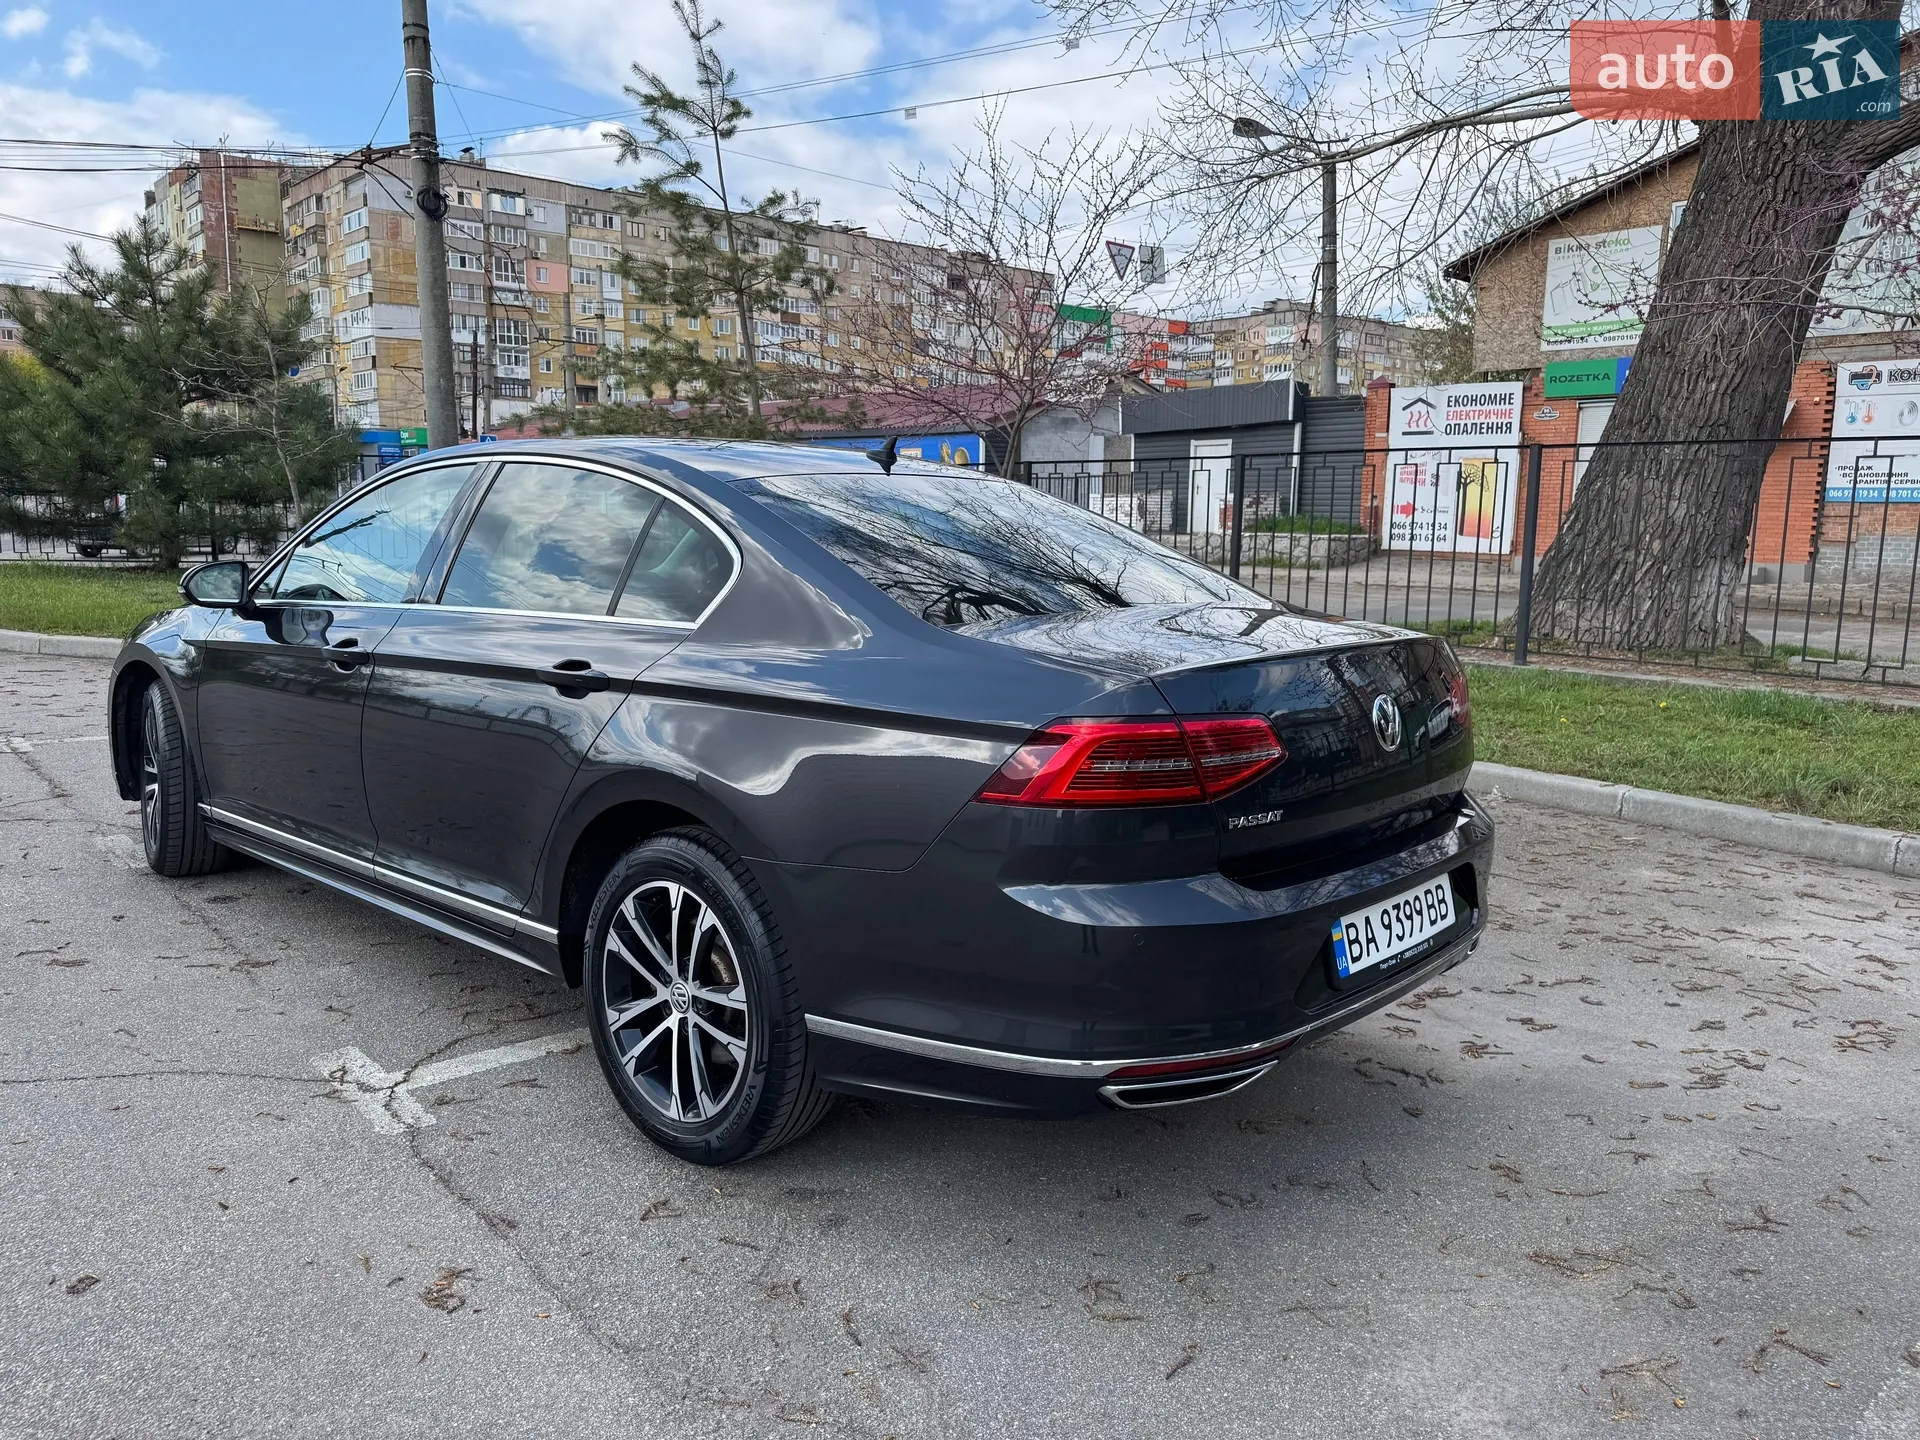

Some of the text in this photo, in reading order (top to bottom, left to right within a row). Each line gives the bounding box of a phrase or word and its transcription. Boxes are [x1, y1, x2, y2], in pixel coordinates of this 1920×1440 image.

[1549, 372, 1611, 384] ROZETKA
[1446, 392, 1515, 408] ЕКОНОМНЕ
[1445, 408, 1514, 421] ЕЛЕКТРИЧНЕ
[1444, 421, 1512, 436] ОПАЛЕННЯ
[1829, 489, 1843, 498] 066
[1858, 489, 1868, 498] 19
[1868, 489, 1878, 498] 34
[1882, 489, 1897, 498] 08
[1897, 489, 1911, 498] 701
[1392, 521, 1407, 530] 066
[1437, 522, 1448, 531] 34
[1391, 532, 1406, 541] 098
[1436, 534, 1447, 543] 64
[1228, 809, 1284, 830] PASSAT
[588, 869, 621, 930] VREDESTEIN
[1380, 894, 1424, 949] 9399
[1336, 955, 1348, 970] UA
[715, 1083, 758, 1145] VREDESTEIN
